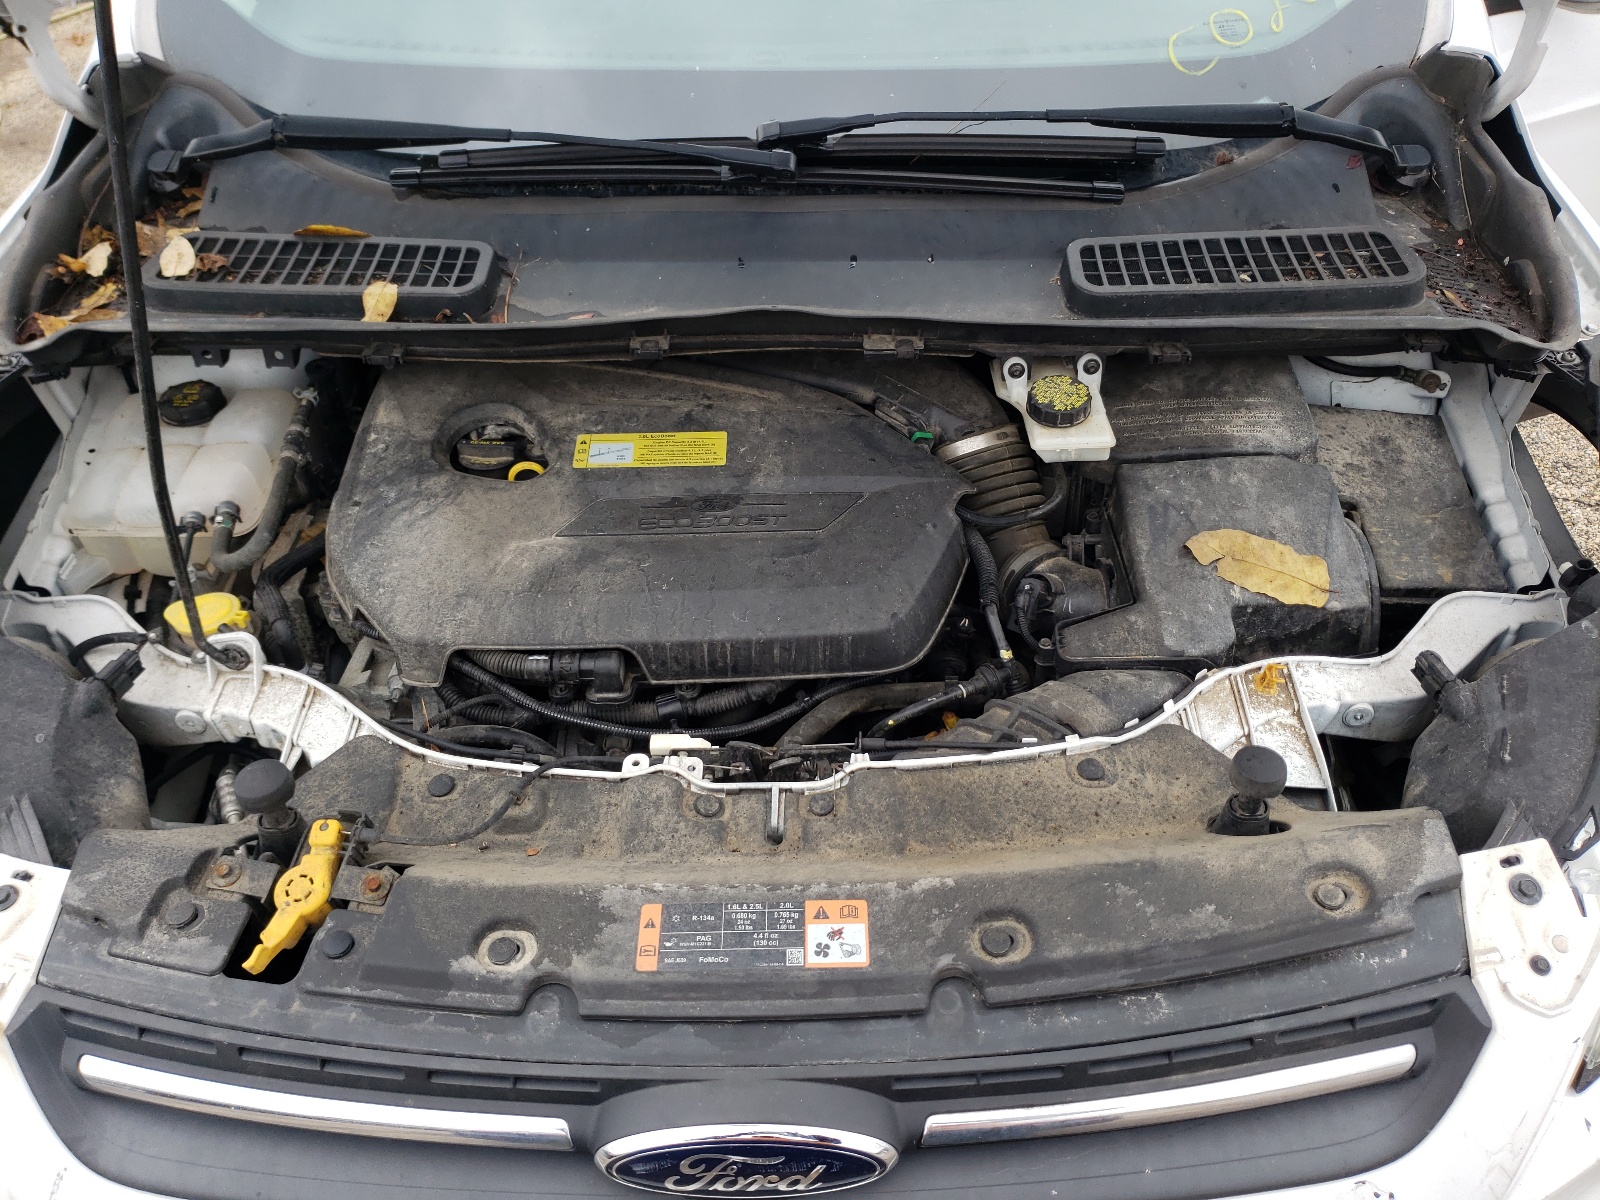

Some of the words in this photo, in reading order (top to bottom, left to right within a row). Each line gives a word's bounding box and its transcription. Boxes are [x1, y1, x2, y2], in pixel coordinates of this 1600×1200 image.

[638, 514, 787, 530] ECOBOOST
[748, 912, 757, 920] kg
[791, 911, 799, 919] kg
[664, 1154, 827, 1191] Ford
